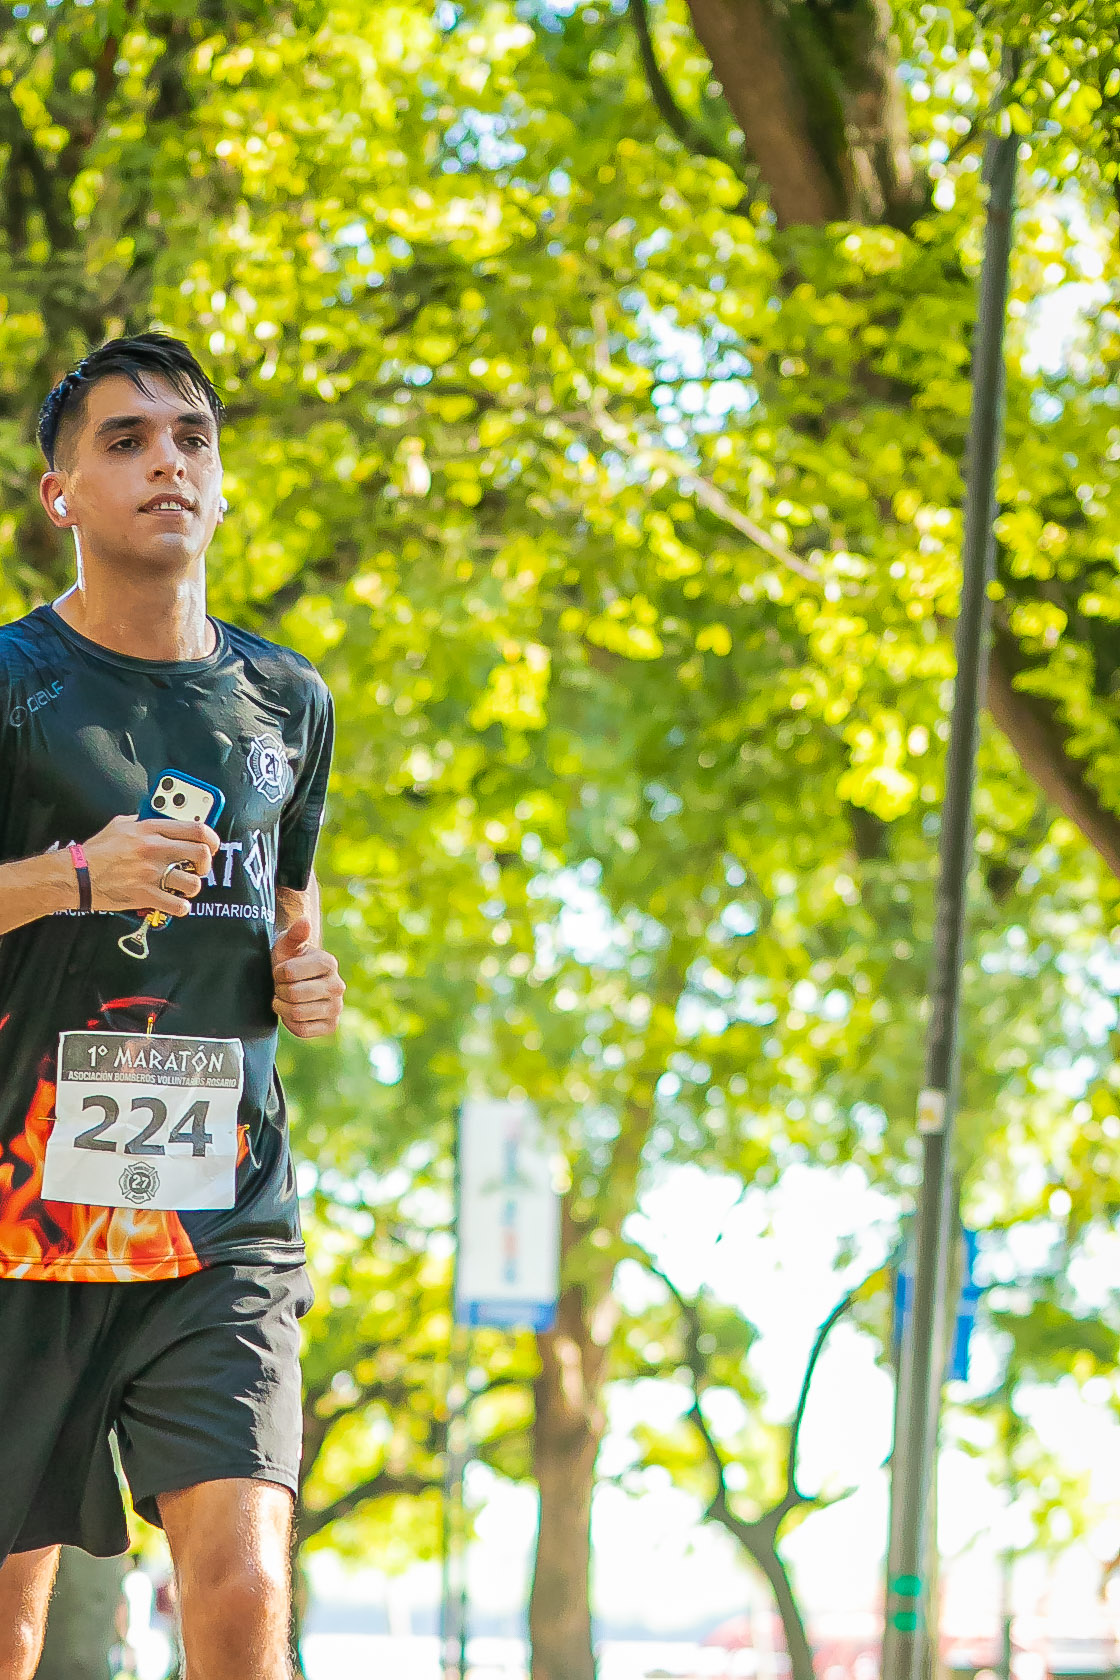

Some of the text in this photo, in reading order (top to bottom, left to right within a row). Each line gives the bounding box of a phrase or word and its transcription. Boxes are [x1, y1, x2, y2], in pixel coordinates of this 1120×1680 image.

[189, 902, 259, 920] LUNTARIOS
[114, 1045, 224, 1073] MARATÓN
[68, 1070, 237, 1088] ASOCIACIÓN BOMBEROS VOLUNTARIOS ROSARIO
[74, 1095, 213, 1157] 224
[131, 1174, 150, 1190] 27
